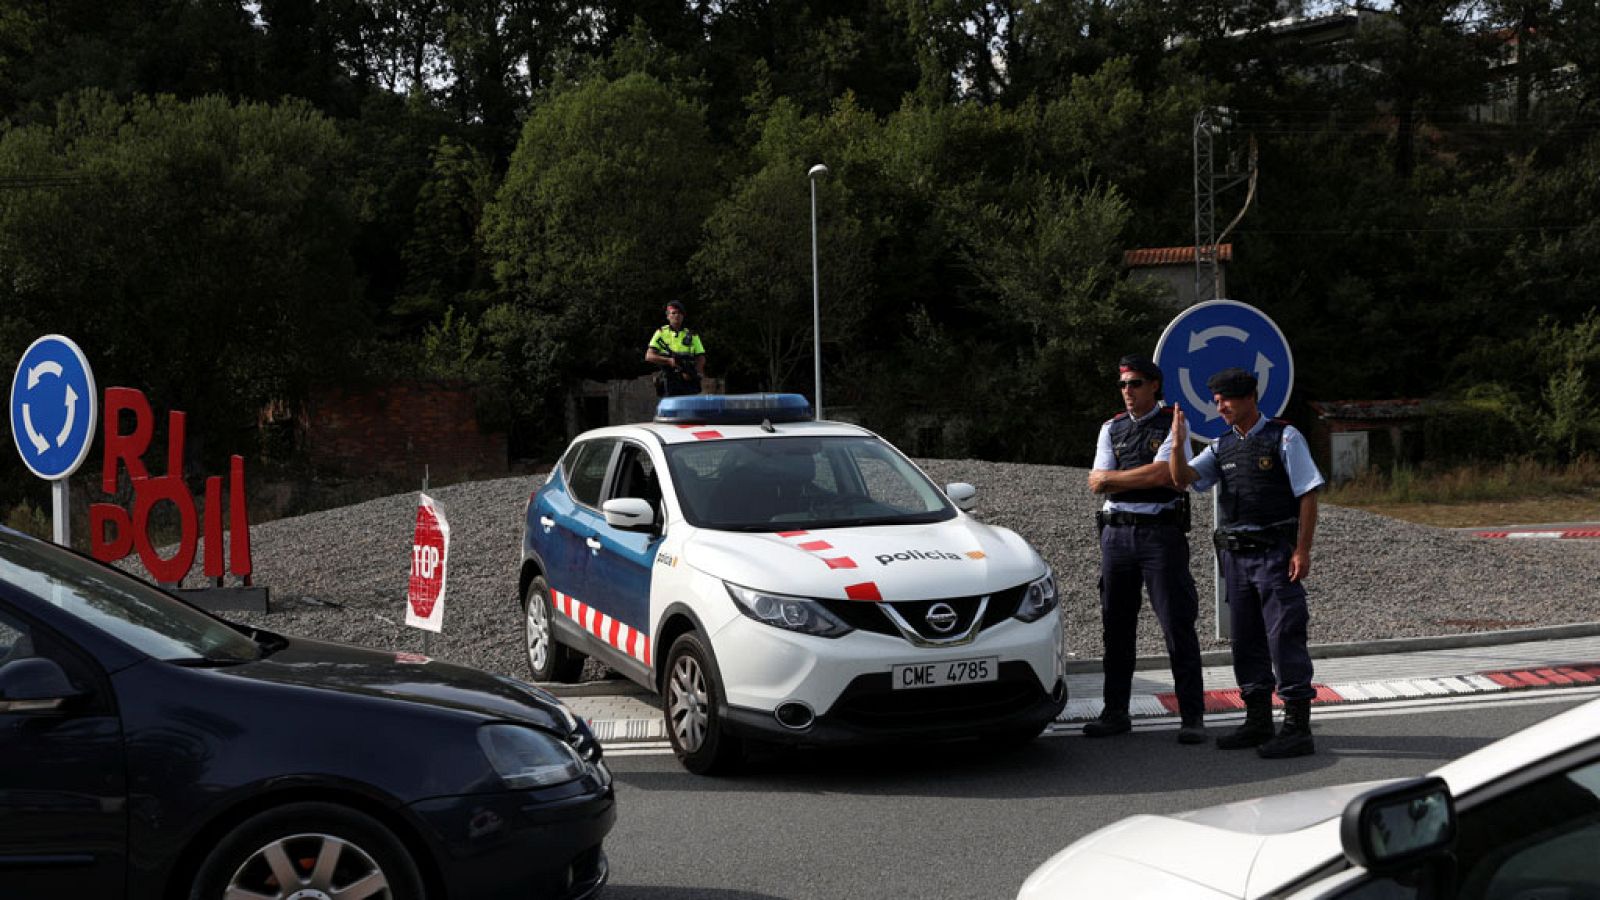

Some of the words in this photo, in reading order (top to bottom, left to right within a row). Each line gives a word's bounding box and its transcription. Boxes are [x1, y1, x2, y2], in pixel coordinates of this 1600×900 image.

[103, 387, 187, 494] RI
[411, 545, 439, 579] TOP
[875, 549, 961, 566] policia
[902, 666, 937, 686] CME
[947, 660, 989, 682] 4785
